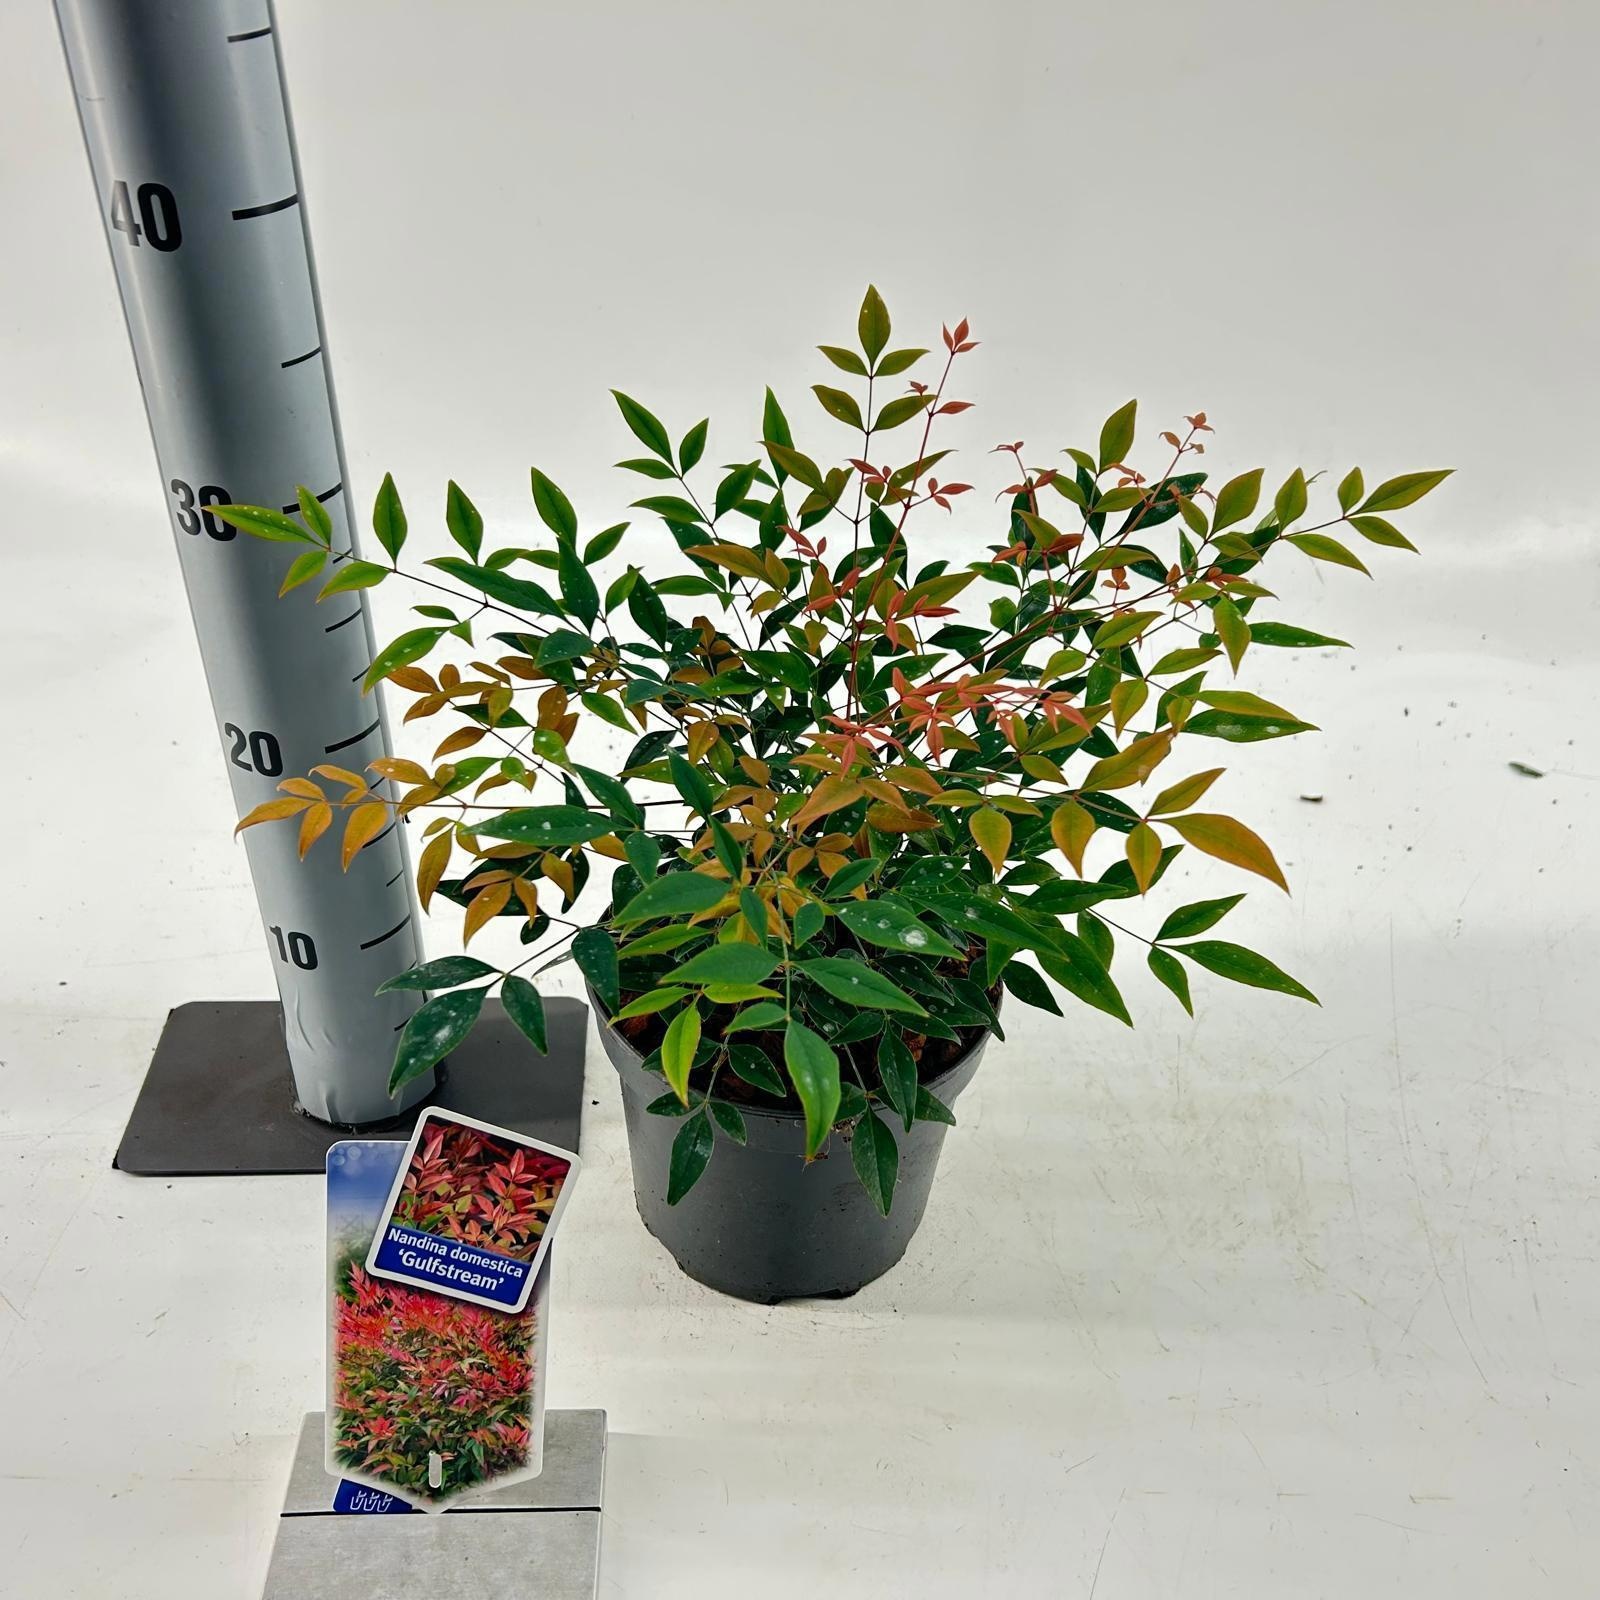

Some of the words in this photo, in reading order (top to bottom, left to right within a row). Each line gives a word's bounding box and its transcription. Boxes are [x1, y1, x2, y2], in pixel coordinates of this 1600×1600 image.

[110, 180, 182, 252] 40
[170, 478, 238, 542] 30
[224, 722, 283, 777] 20
[270, 925, 318, 970] 10
[388, 1228, 448, 1256] Nandina
[449, 1248, 523, 1278] domestica
[398, 1248, 504, 1291] ‘Gulfstream’
